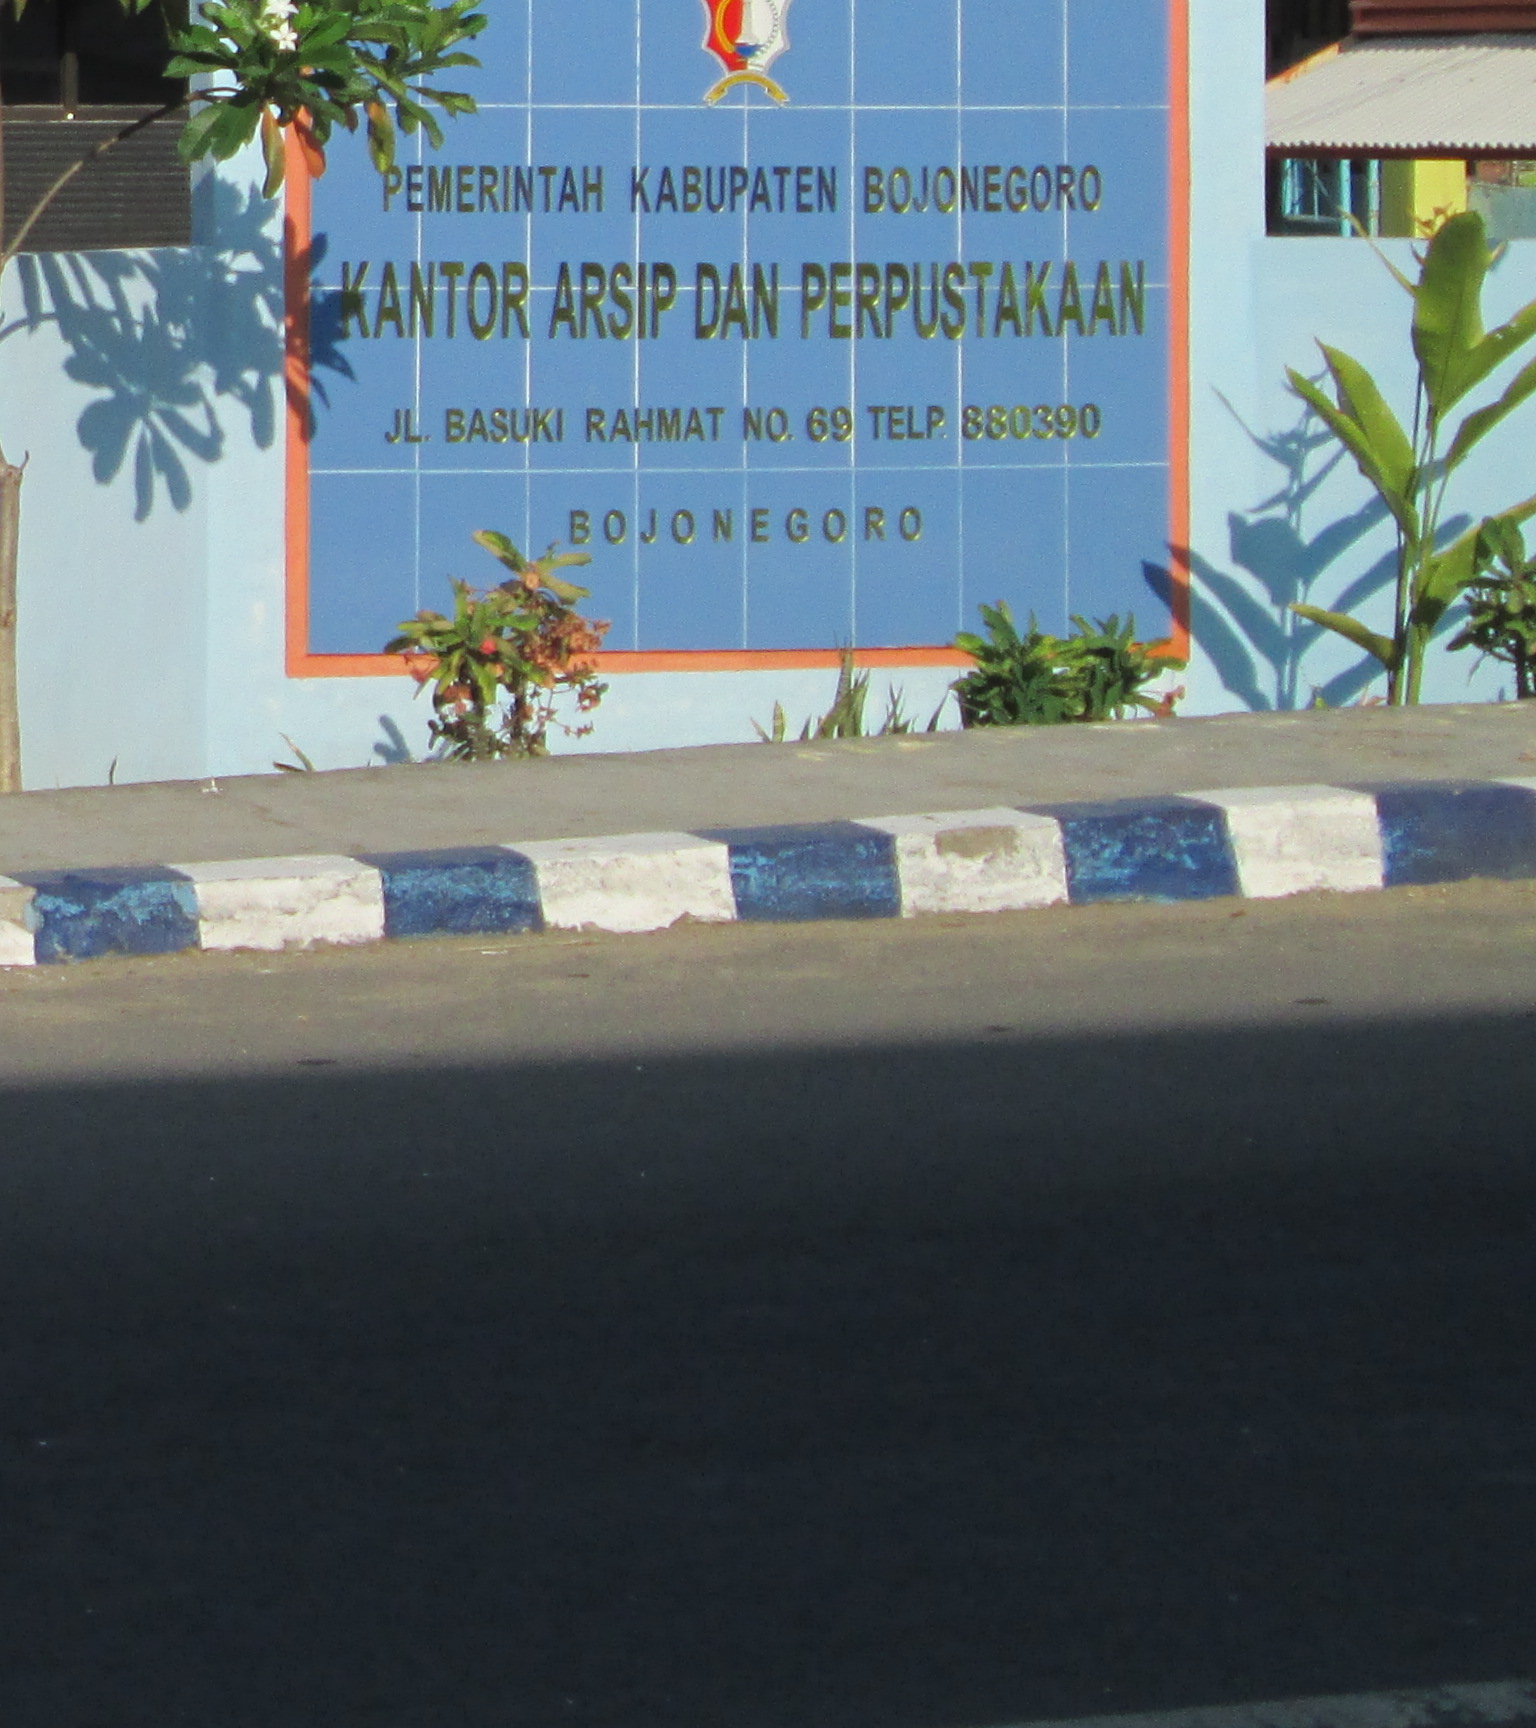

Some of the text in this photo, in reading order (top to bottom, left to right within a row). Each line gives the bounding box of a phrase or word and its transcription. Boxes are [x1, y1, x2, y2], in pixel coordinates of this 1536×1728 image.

[382, 165, 1101, 213] PEMERINTAH KABUPATEN BOJONEGORO
[341, 261, 1144, 341] KANTOR ARSIP DAN PERPUSTAKAAN
[385, 403, 1100, 444] JL. BASUKI RAHMAT NO. 69 TELP. 880390
[570, 506, 923, 544] BOJONEGORO
